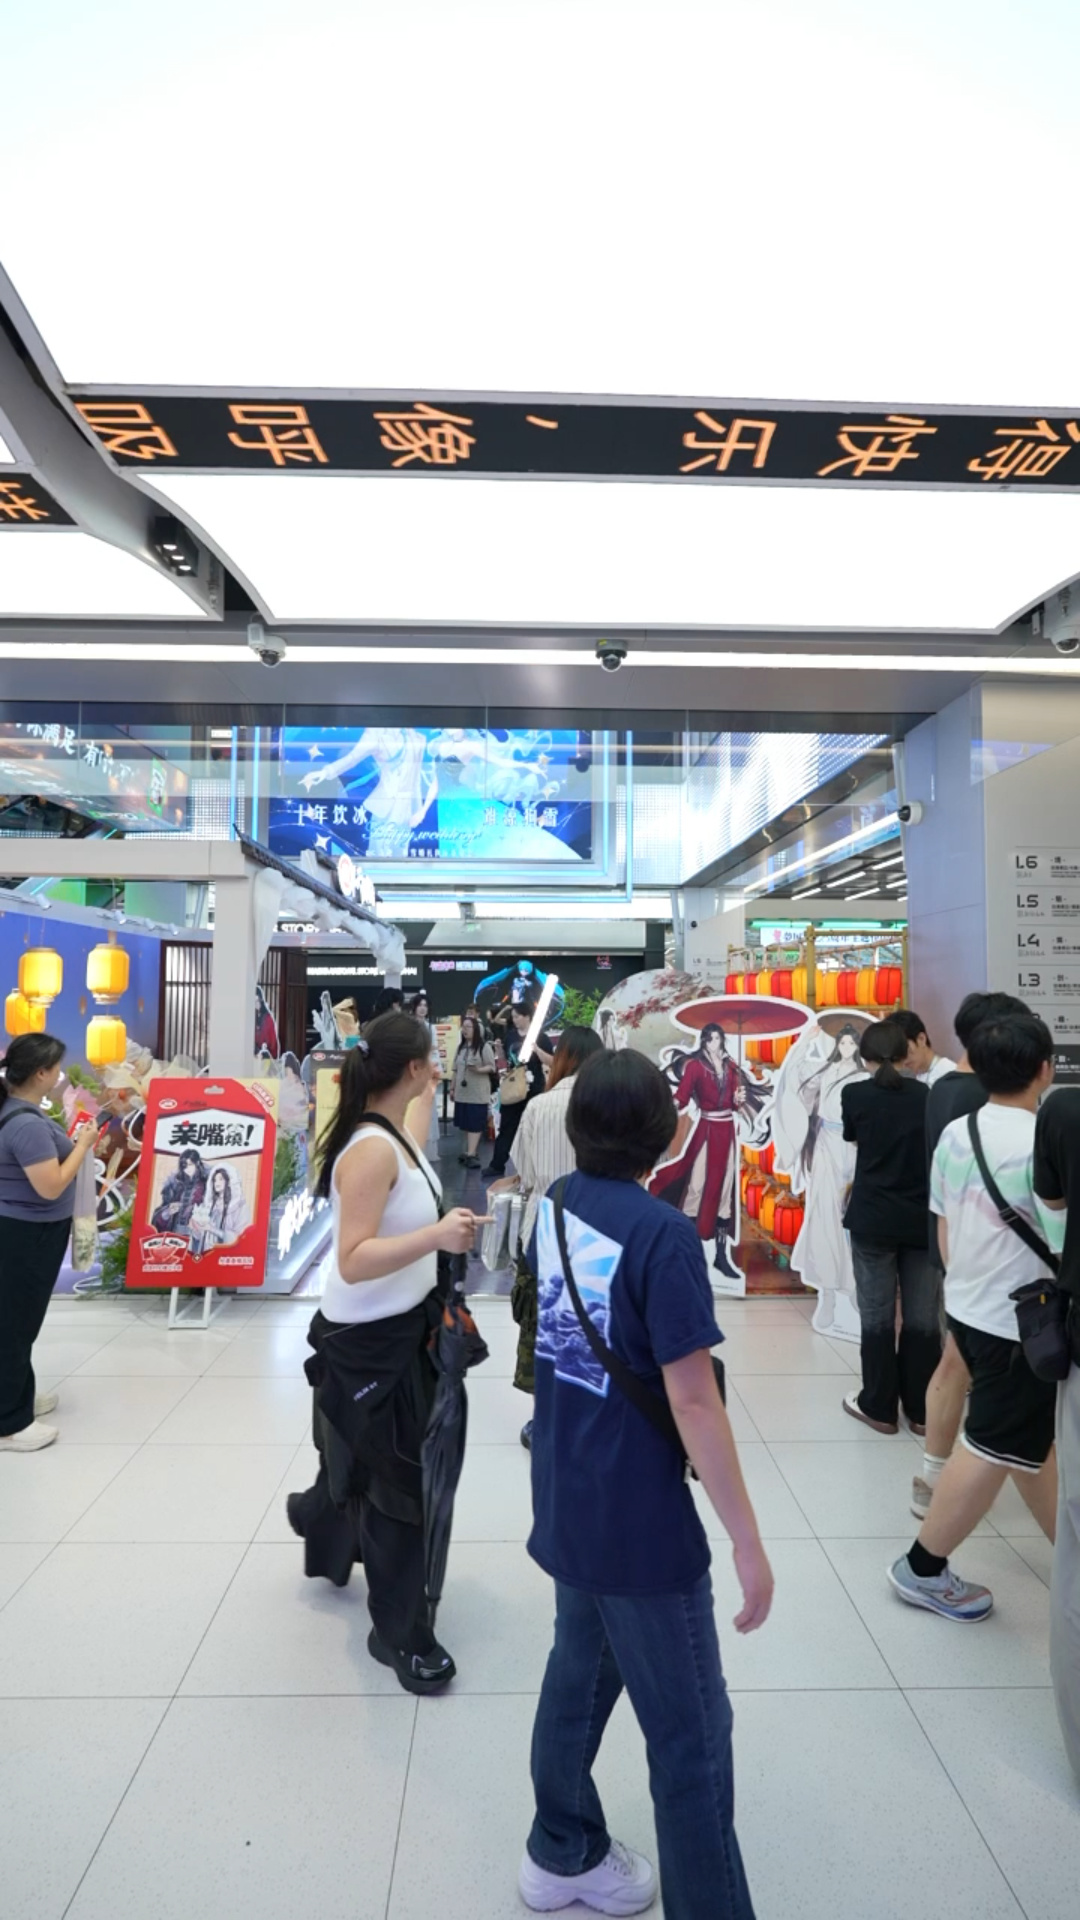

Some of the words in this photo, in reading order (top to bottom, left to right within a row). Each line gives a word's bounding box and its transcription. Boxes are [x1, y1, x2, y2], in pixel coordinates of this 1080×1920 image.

[1016, 855, 1038, 869] L6
[1017, 894, 1039, 908] L5
[1018, 933, 1040, 948] L4
[1018, 973, 1040, 988] L3
